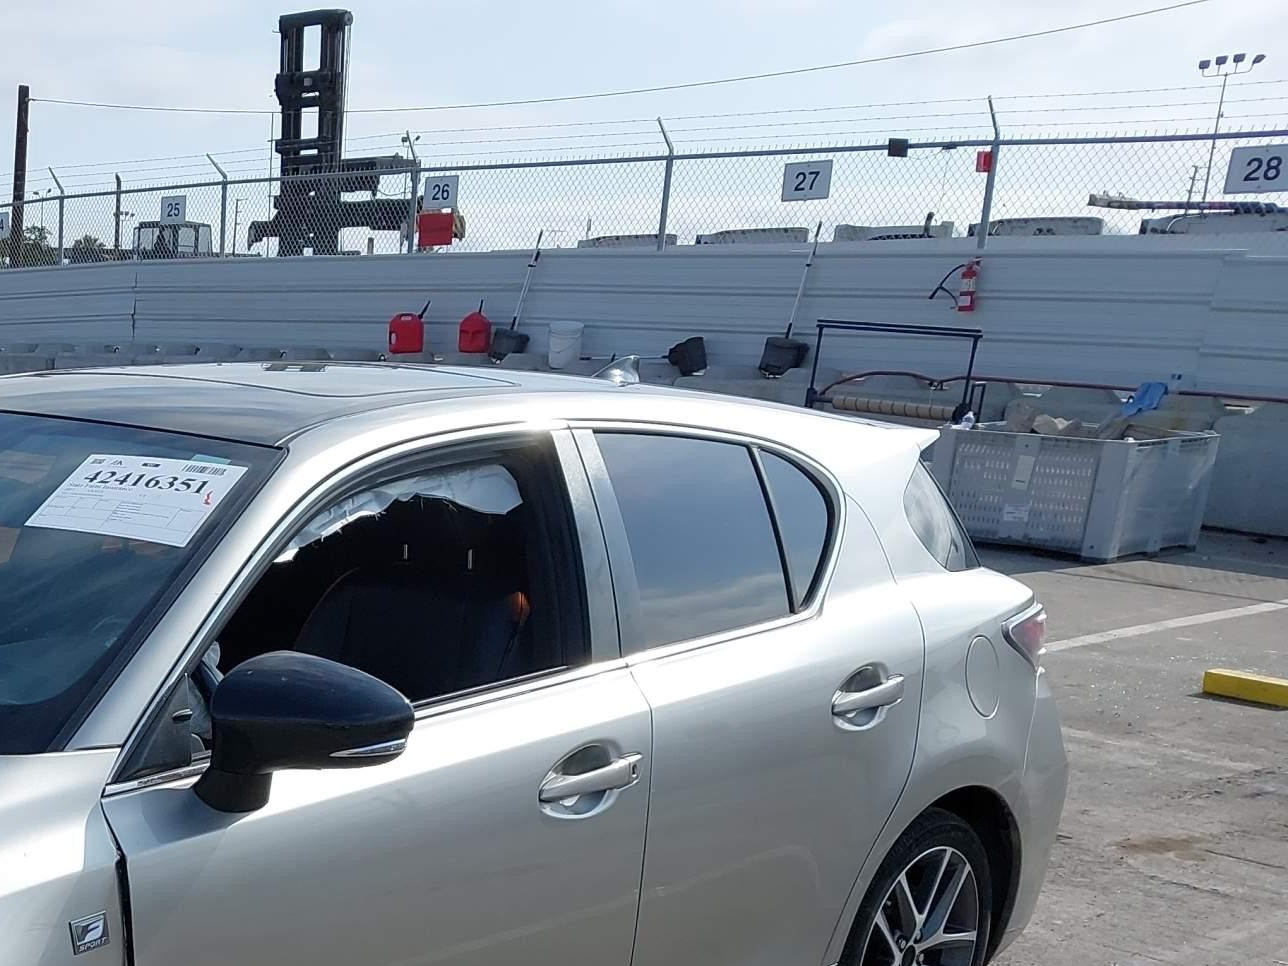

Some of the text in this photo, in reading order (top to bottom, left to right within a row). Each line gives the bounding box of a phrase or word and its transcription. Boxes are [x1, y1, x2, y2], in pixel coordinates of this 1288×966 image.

[1243, 155, 1283, 182] 28
[793, 170, 820, 192] 27
[431, 183, 451, 201] 26
[166, 202, 181, 217] 25
[84, 470, 209, 494] 42416351
[78, 937, 107, 952] SPORT
